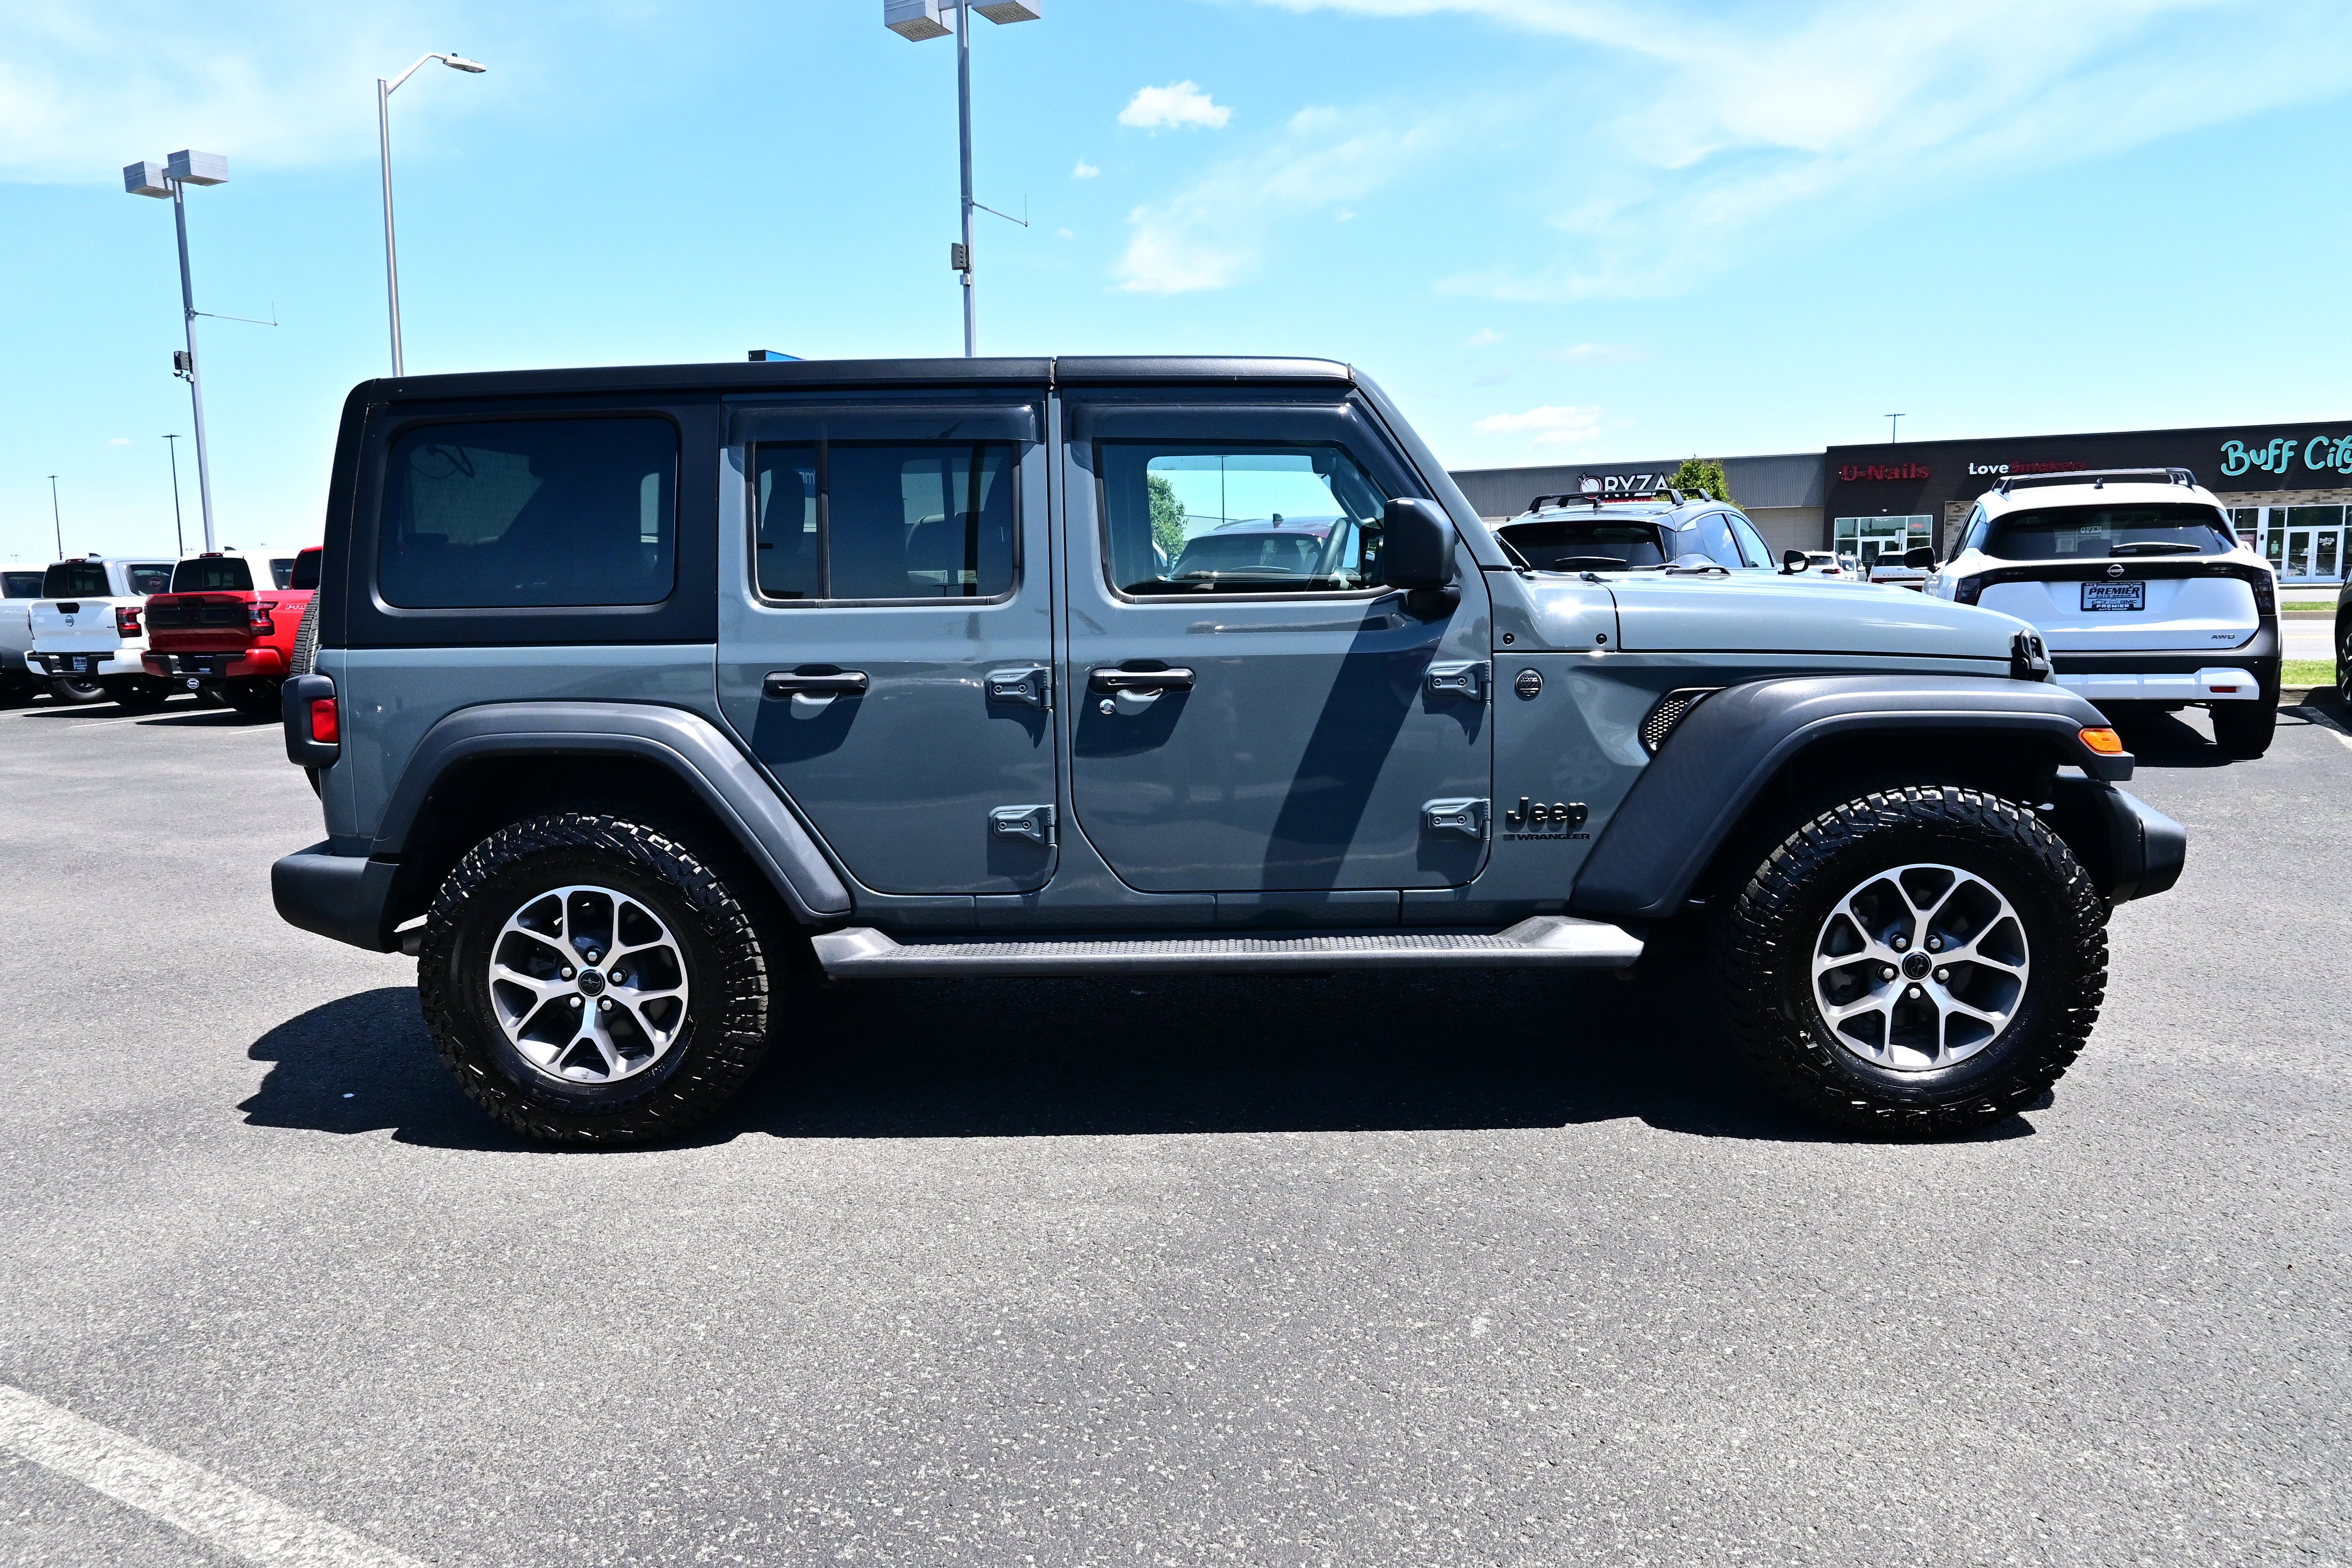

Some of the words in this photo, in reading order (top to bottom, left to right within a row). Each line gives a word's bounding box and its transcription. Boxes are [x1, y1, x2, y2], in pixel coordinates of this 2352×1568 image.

[2221, 438, 2298, 476] Buff
[1842, 463, 1931, 481] U-Nails
[2088, 587, 2140, 598] PREMIER
[1505, 797, 1589, 828] Jeep
